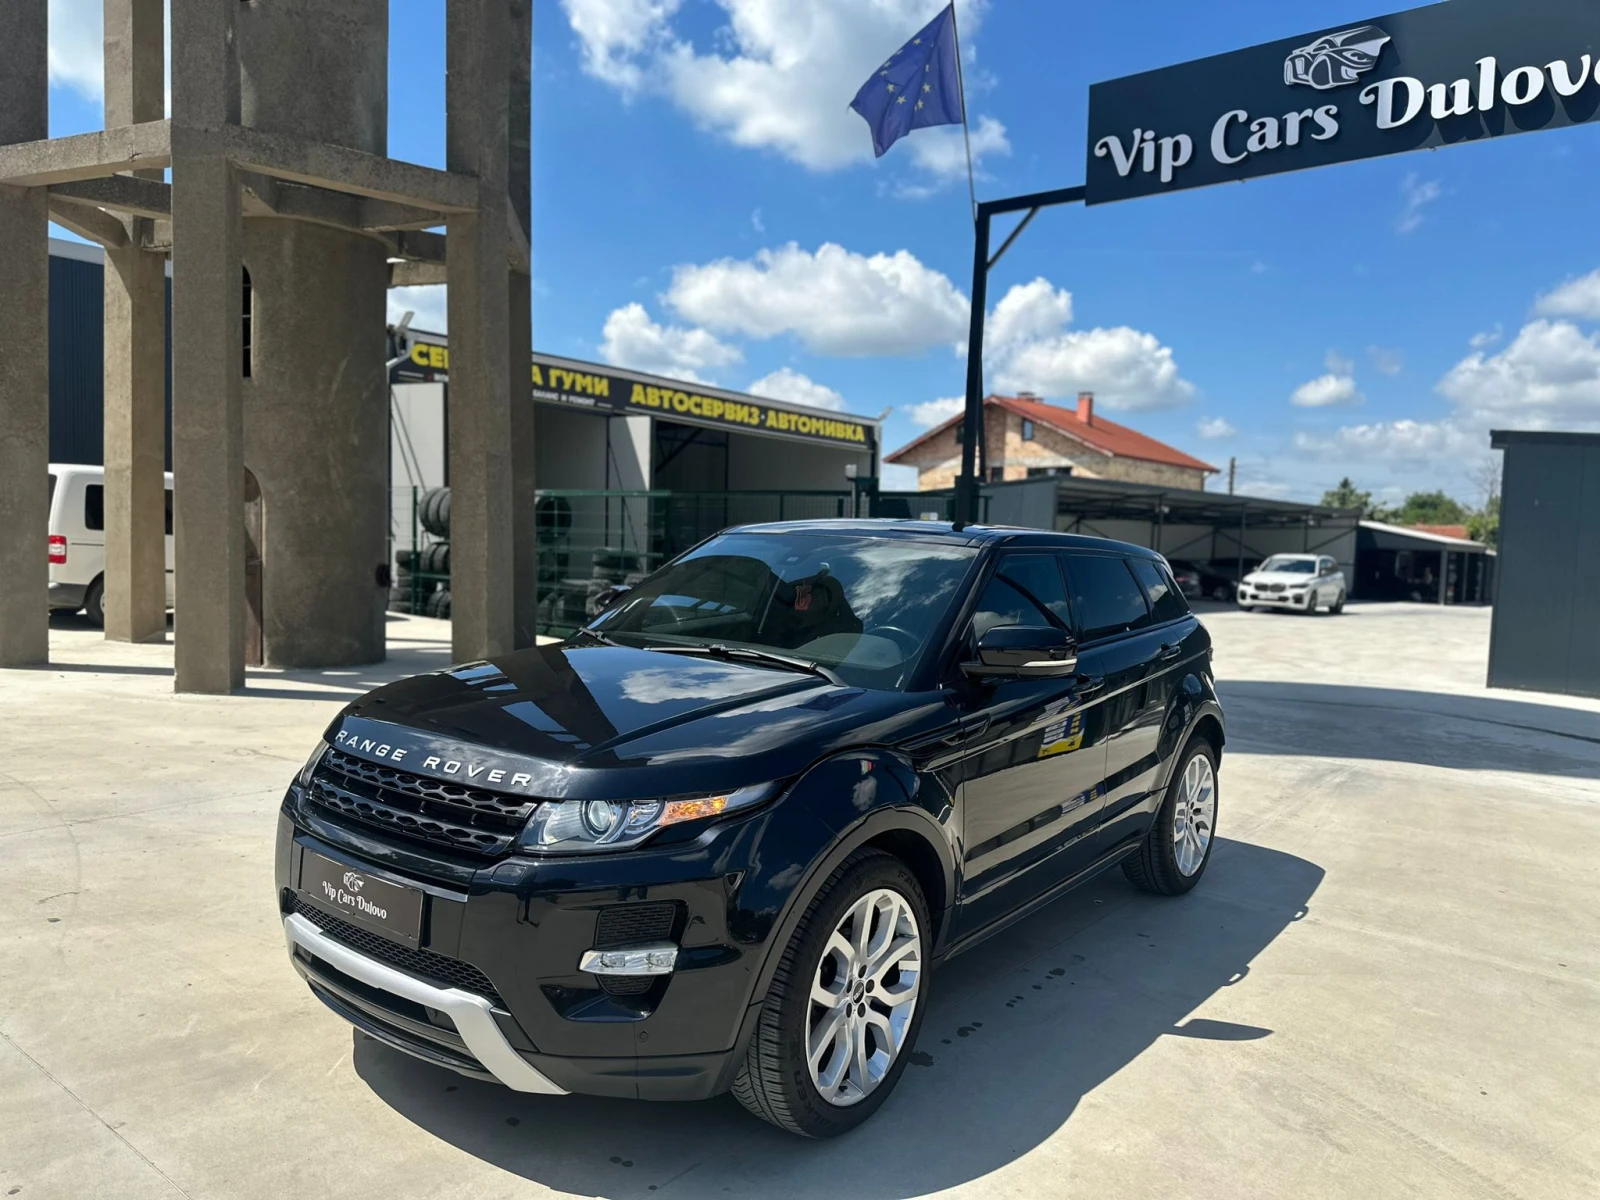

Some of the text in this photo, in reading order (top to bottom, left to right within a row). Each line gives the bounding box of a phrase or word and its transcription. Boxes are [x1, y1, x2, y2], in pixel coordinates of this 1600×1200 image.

[1094, 53, 1600, 183] Vip Cars Dulov
[410, 343, 448, 369] СЕ
[549, 370, 609, 397] ГУМИ
[630, 384, 865, 443] АВТОСЕРВИЗ АВТОМИВКА
[335, 729, 533, 787] RANGE ROVER
[322, 880, 387, 919] Vip Cars Dulovo
